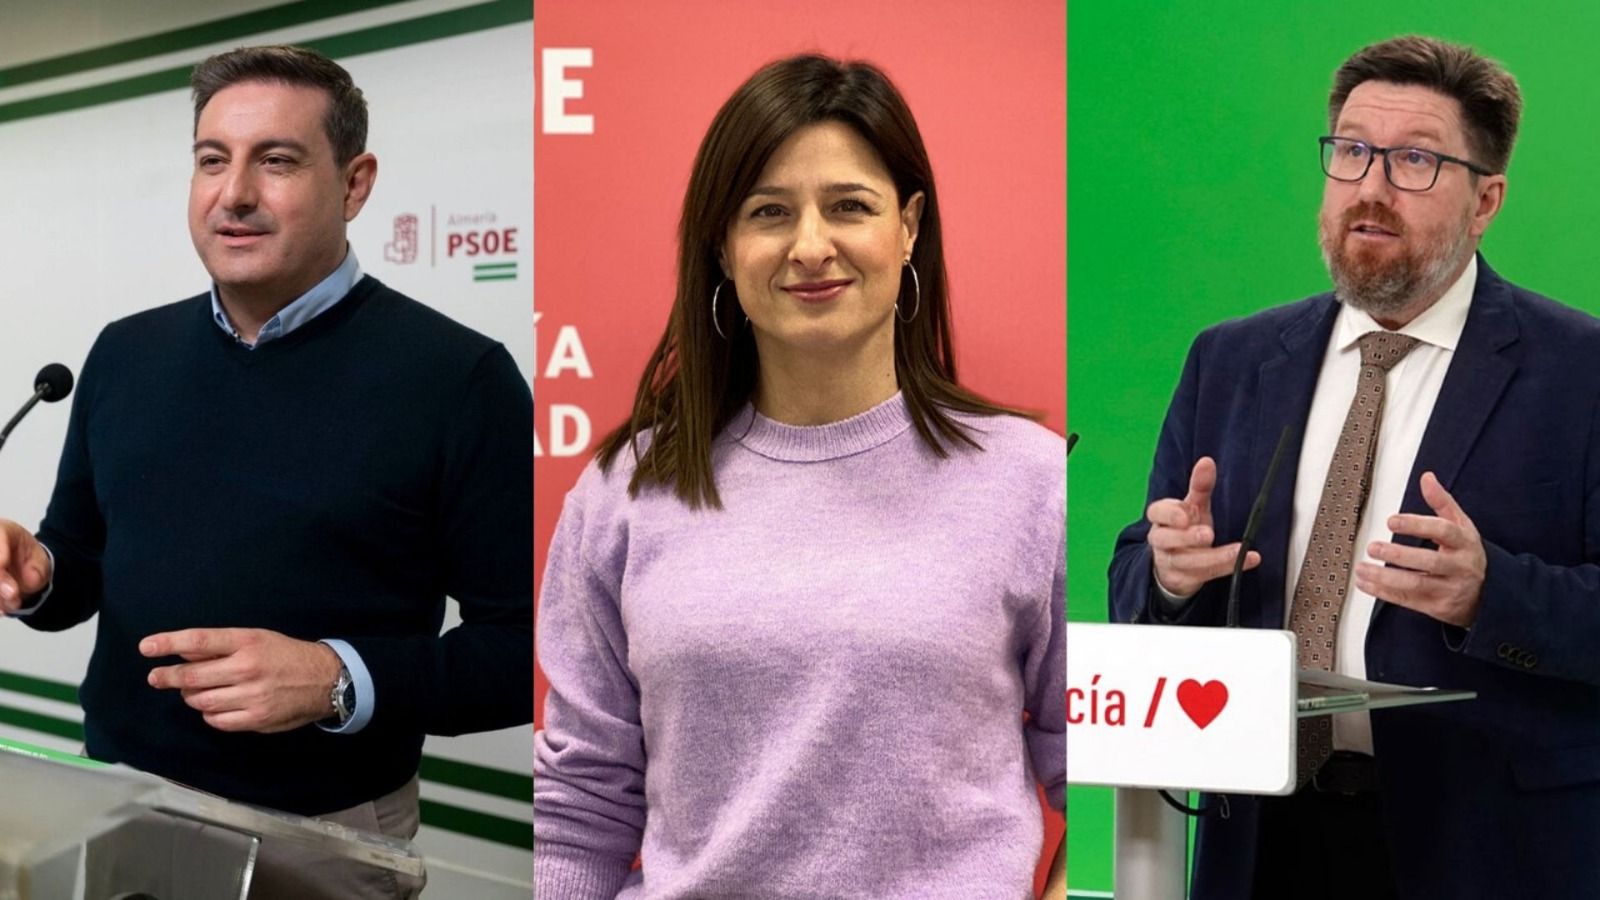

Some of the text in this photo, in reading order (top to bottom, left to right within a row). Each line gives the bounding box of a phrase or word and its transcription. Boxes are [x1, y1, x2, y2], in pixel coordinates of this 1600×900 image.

[542, 48, 594, 134] E
[448, 228, 518, 258] PSOE
[1066, 674, 1126, 727] cía
